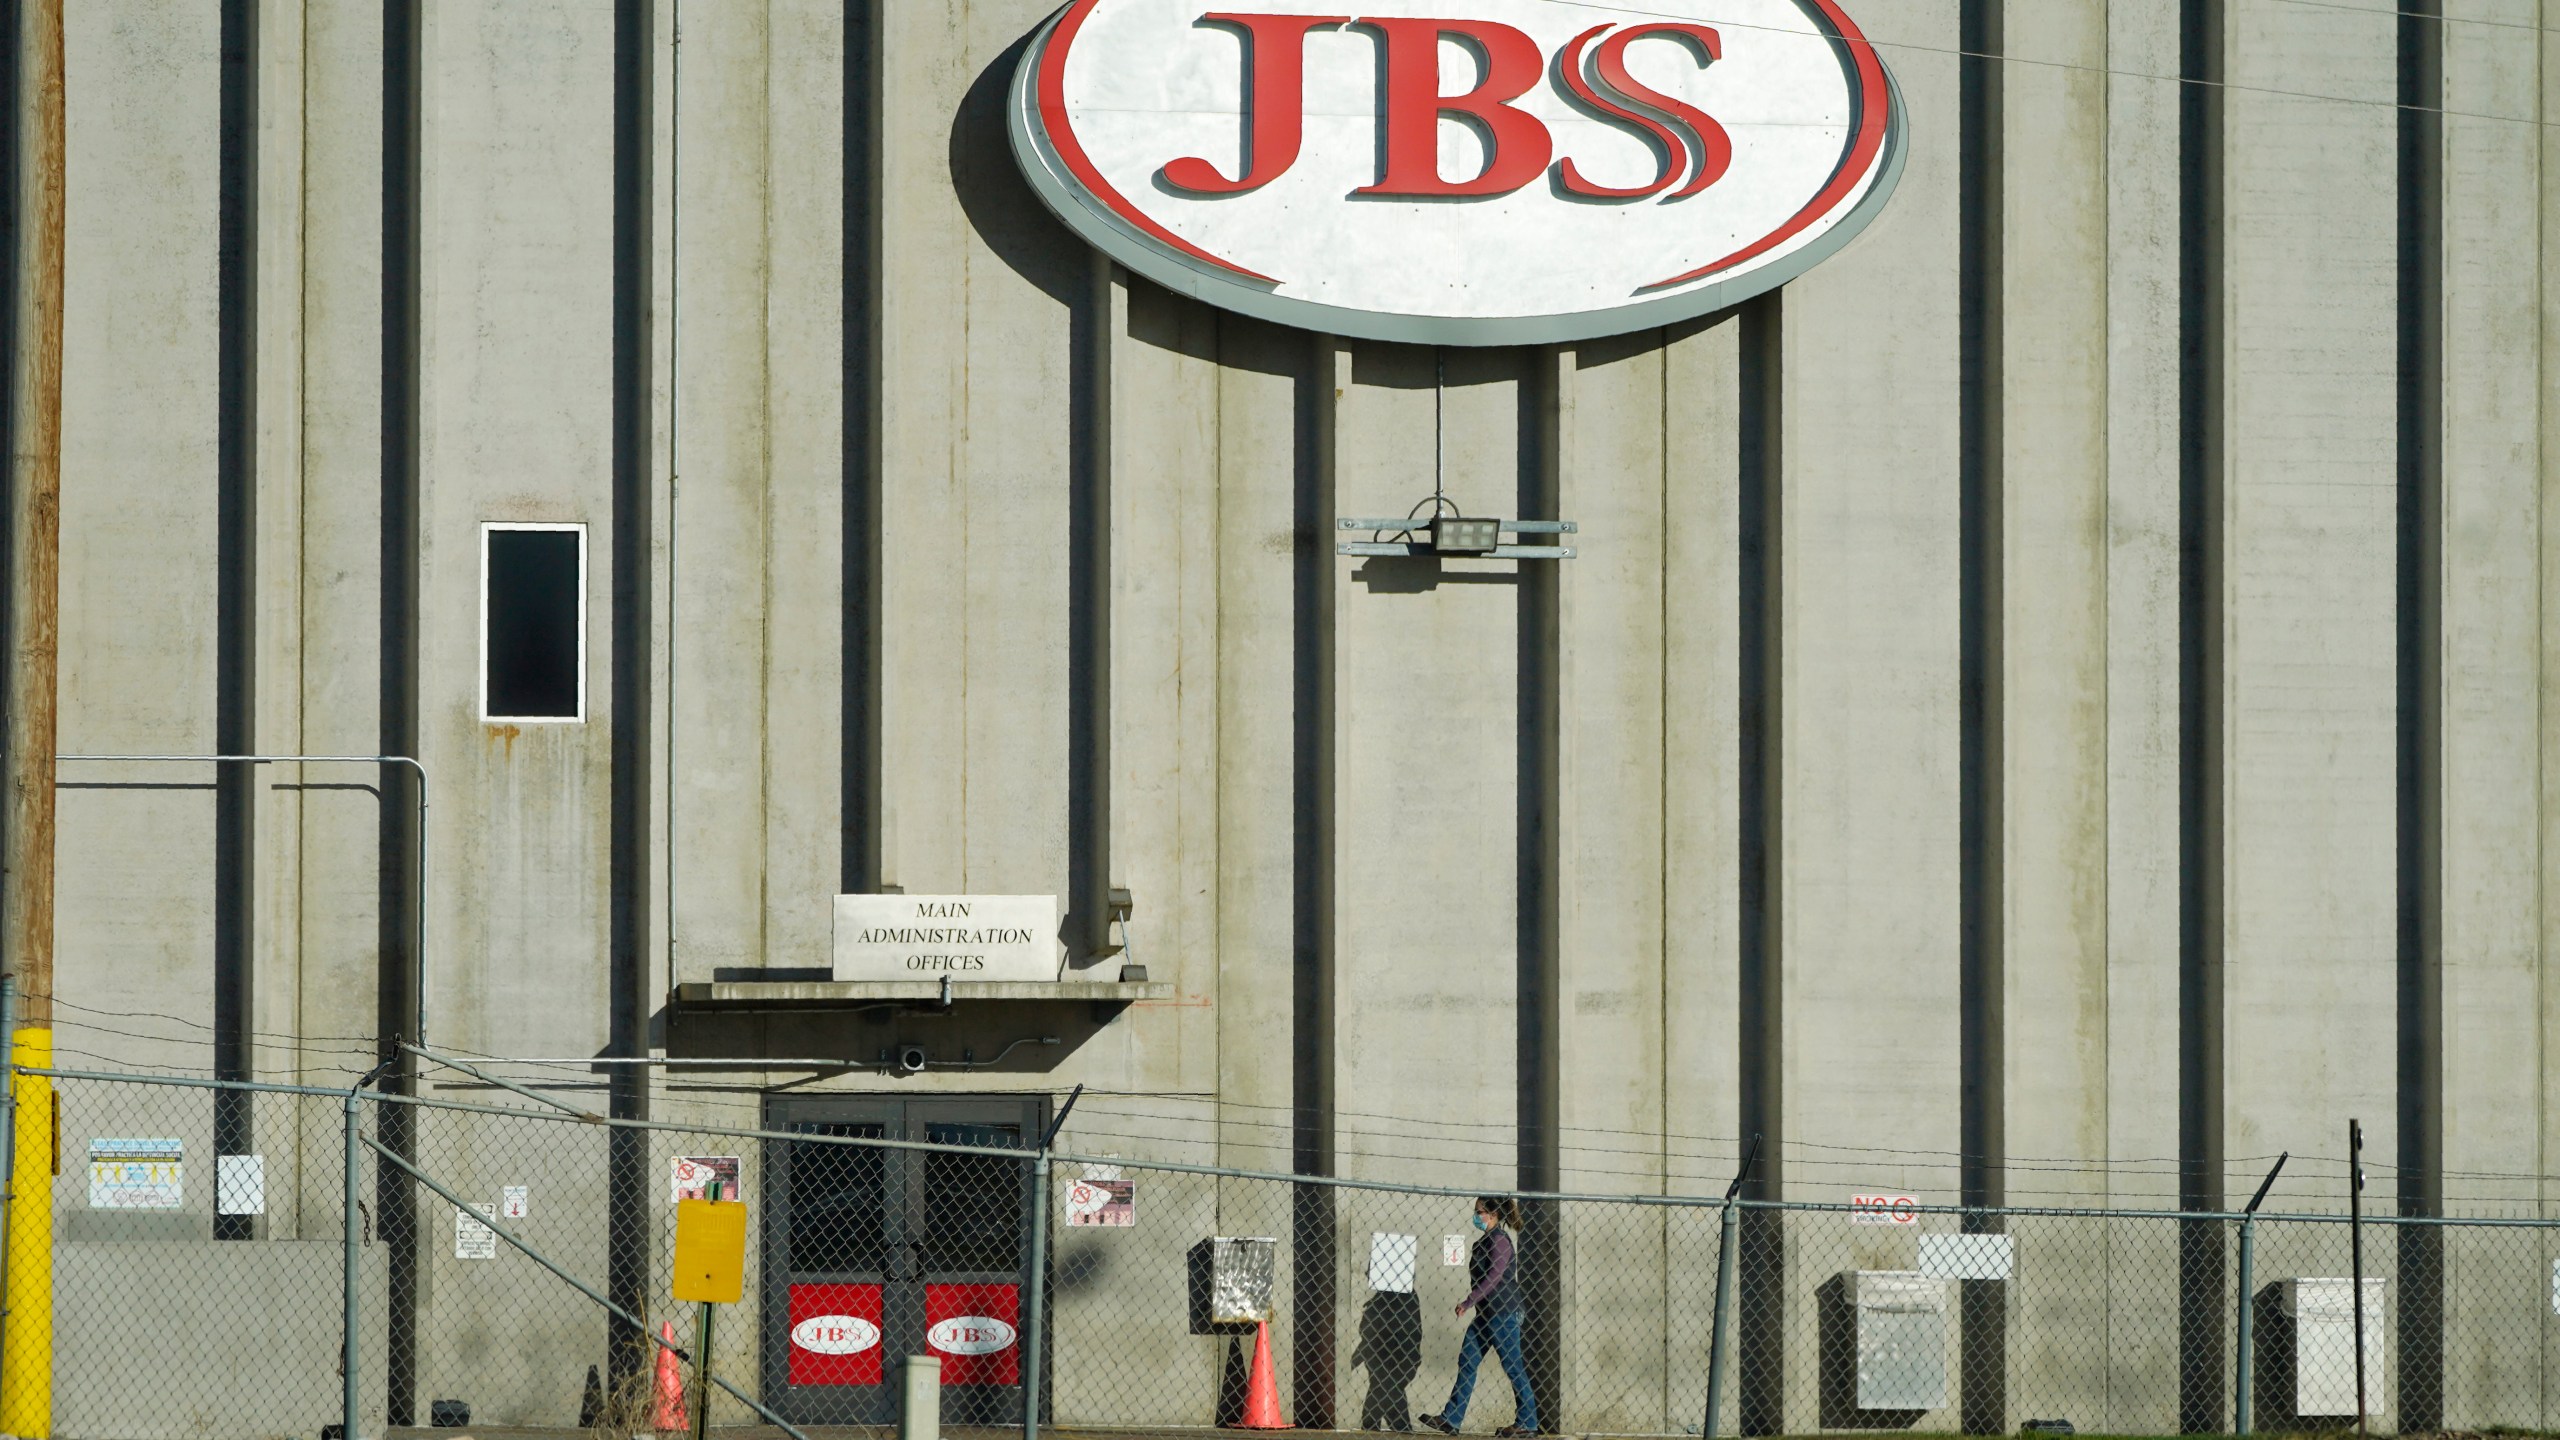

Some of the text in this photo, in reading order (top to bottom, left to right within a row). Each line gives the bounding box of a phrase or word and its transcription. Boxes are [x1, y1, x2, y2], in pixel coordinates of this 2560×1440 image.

[1158, 11, 1733, 203] JBS
[915, 902, 972, 918] MAIN
[857, 928, 1033, 944] ADMINISTRATION
[906, 954, 985, 971] OFFICES
[1855, 1197, 1887, 1214] NO
[808, 1327, 861, 1342] JBS
[944, 1327, 997, 1343] JBS
